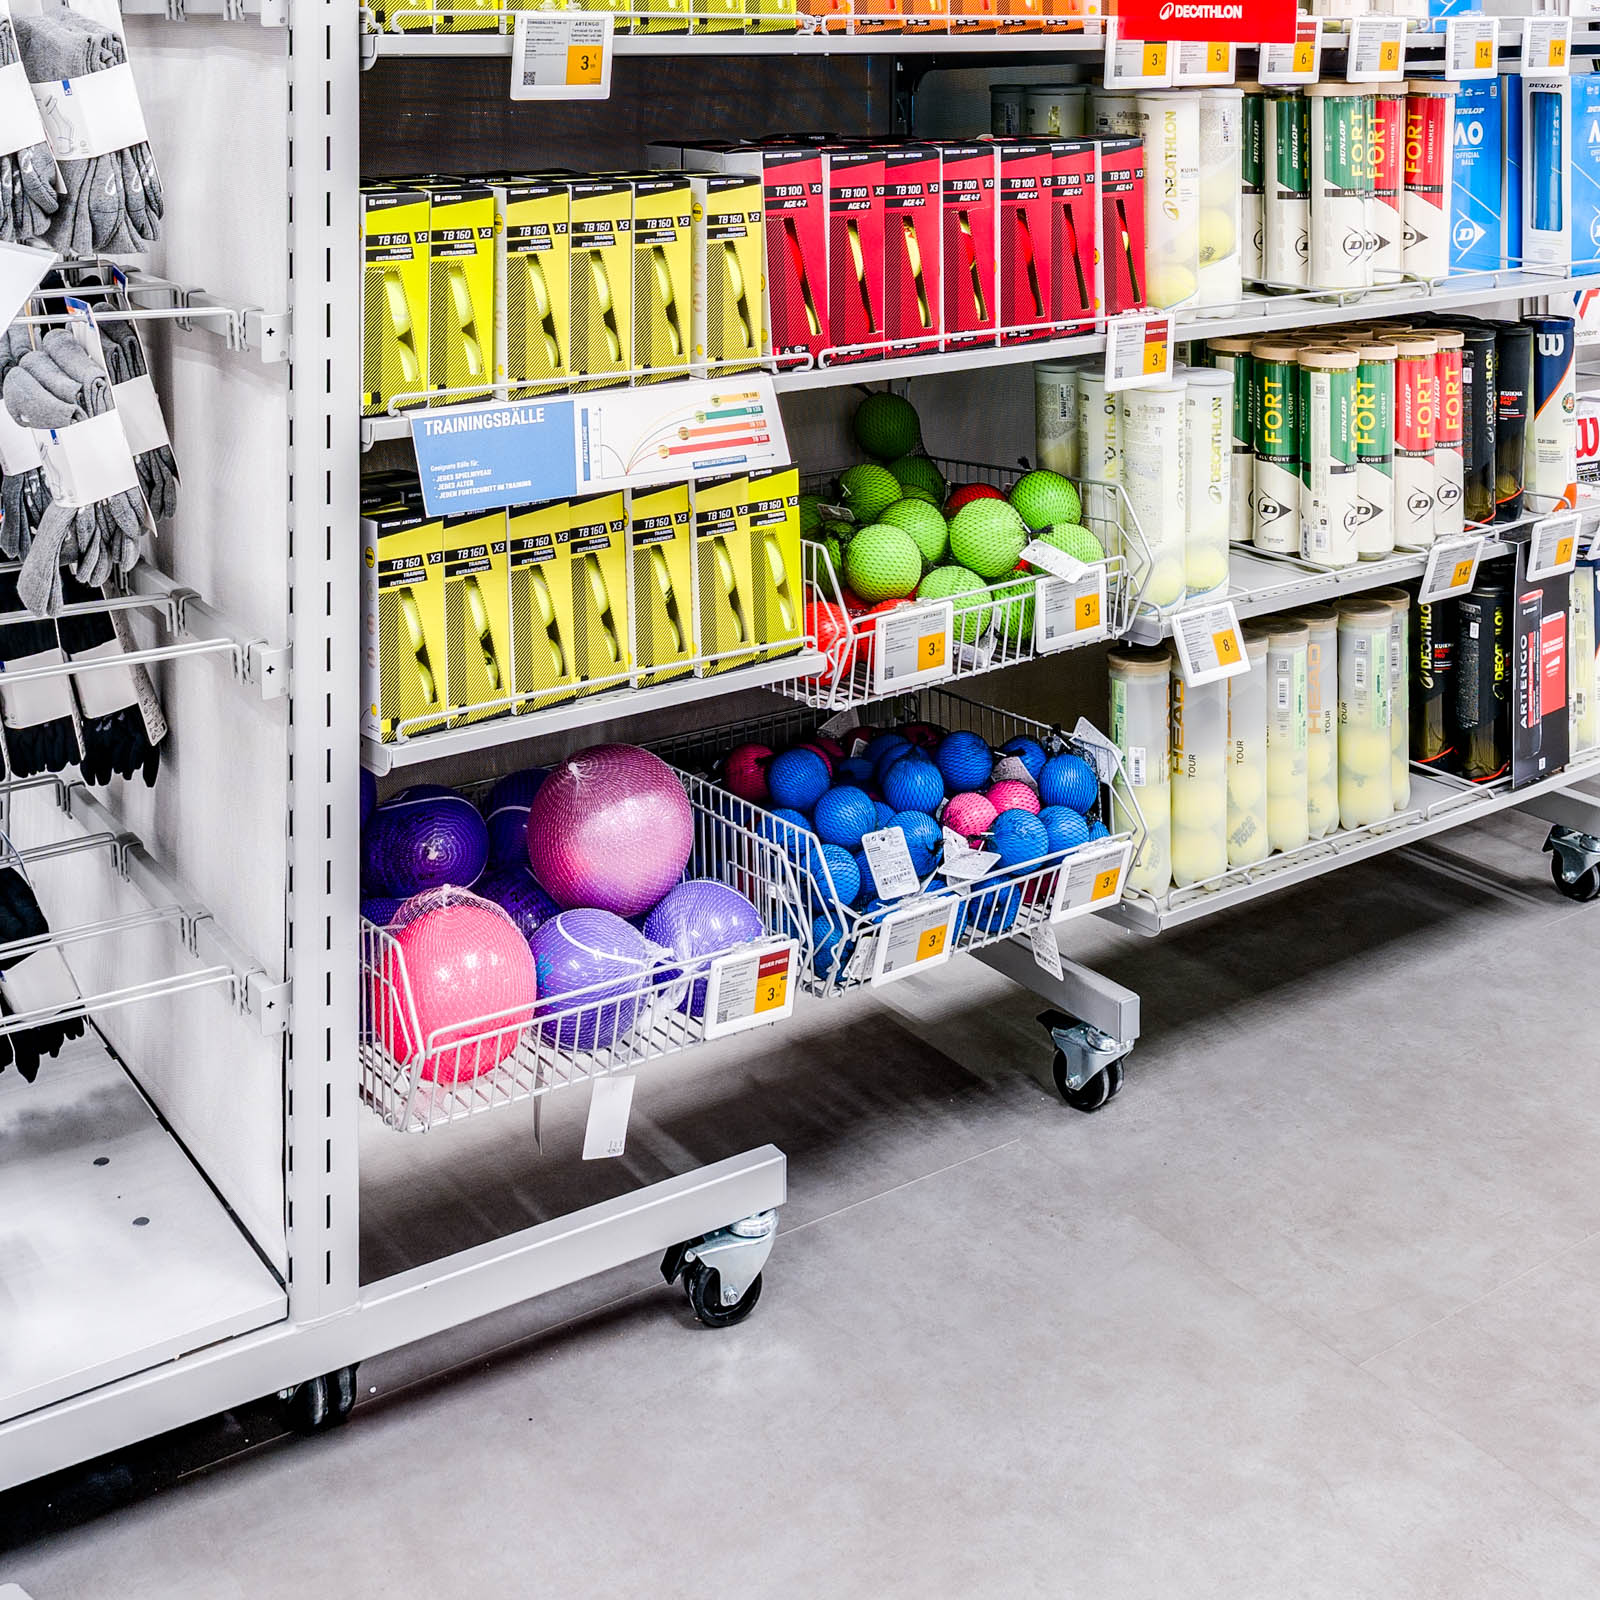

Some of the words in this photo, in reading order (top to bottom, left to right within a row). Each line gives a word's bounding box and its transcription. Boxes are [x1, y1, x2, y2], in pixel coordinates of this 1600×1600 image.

[1175, 4, 1243, 19] DECATHLON
[1405, 109, 1424, 174] FORT
[424, 407, 545, 436] TRAININGSBÄLLE
[1264, 376, 1282, 444] FORT
[1519, 634, 1528, 729] ARTENGO
[1172, 678, 1185, 776] HEAD
[1188, 754, 1197, 779] TOUR
